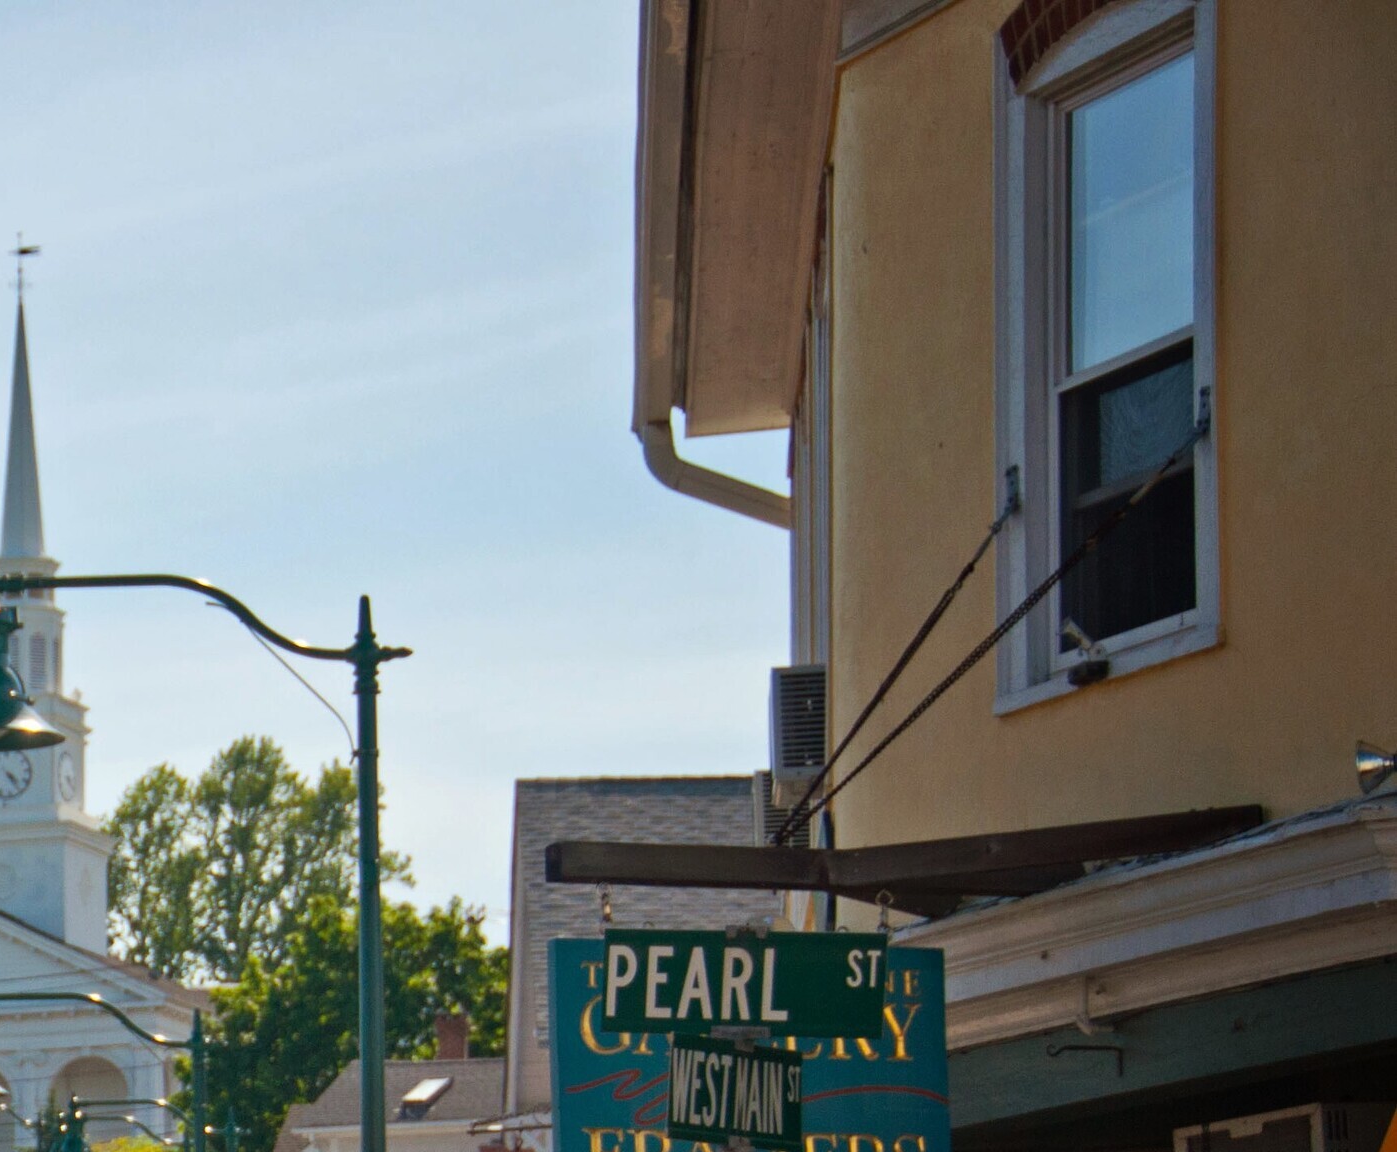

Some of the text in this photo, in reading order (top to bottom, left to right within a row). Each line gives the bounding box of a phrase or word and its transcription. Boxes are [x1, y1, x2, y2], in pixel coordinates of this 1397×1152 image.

[606, 945, 788, 1021] PEARL
[846, 949, 881, 988] ST
[672, 1048, 801, 1135] WEST MAIN ST
